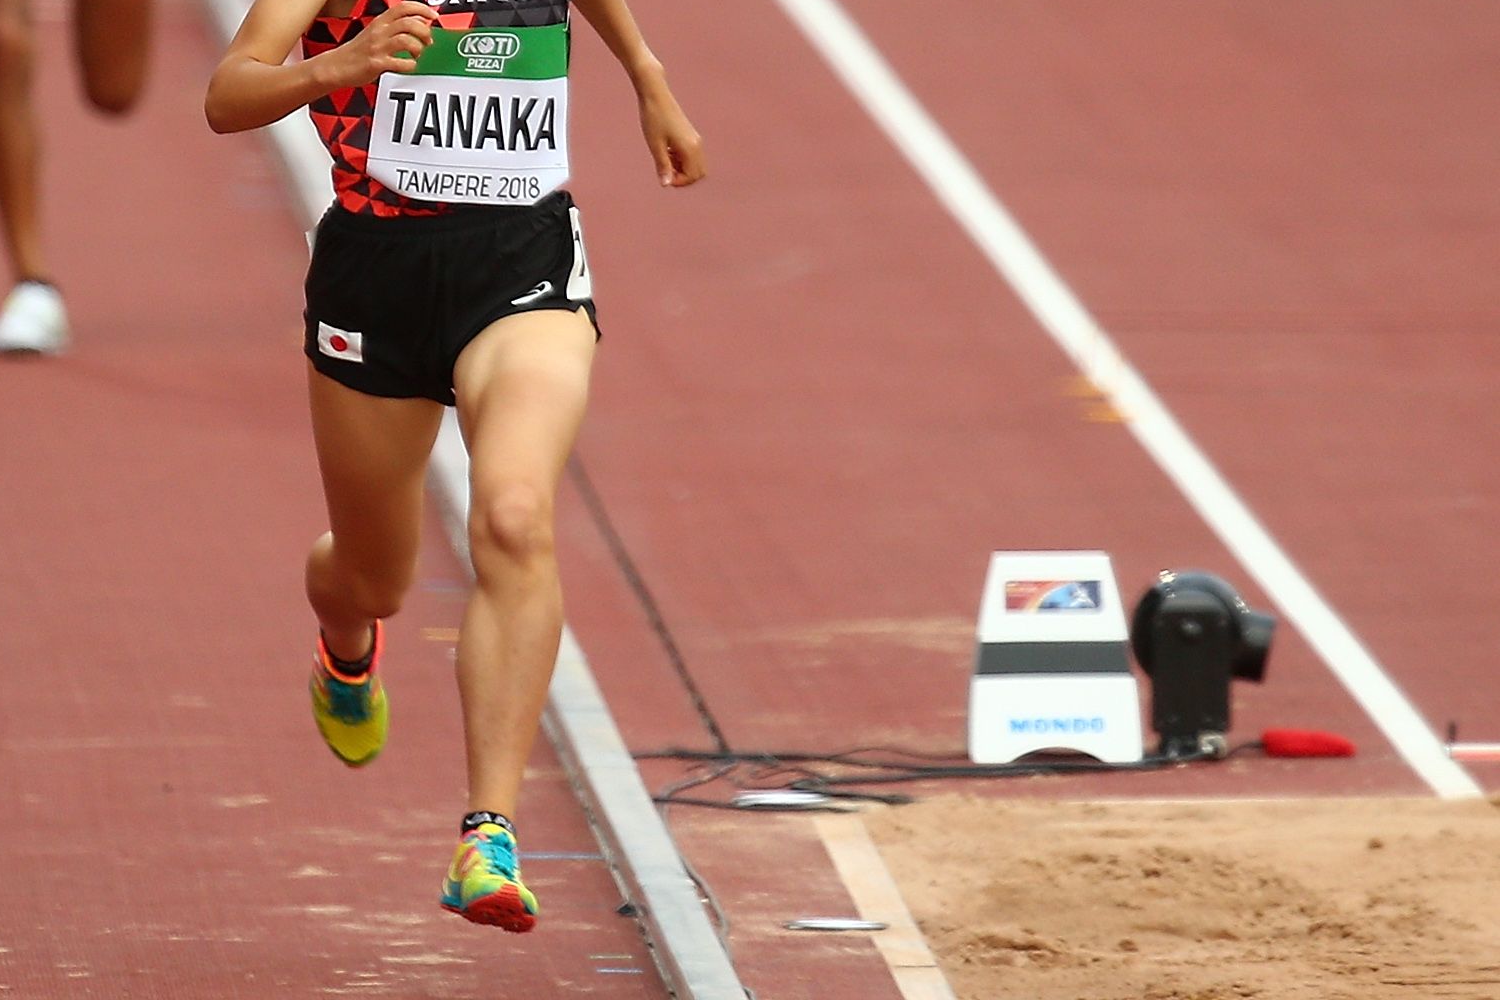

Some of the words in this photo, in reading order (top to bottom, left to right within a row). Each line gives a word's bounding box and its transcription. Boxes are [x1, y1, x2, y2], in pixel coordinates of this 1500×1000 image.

[463, 36, 513, 56] KOTI
[467, 58, 501, 70] PIZZA
[389, 91, 557, 151] TANAKA
[396, 168, 493, 198] TAMPERE
[498, 176, 541, 199] 2018
[1009, 717, 1105, 734] MONDO
